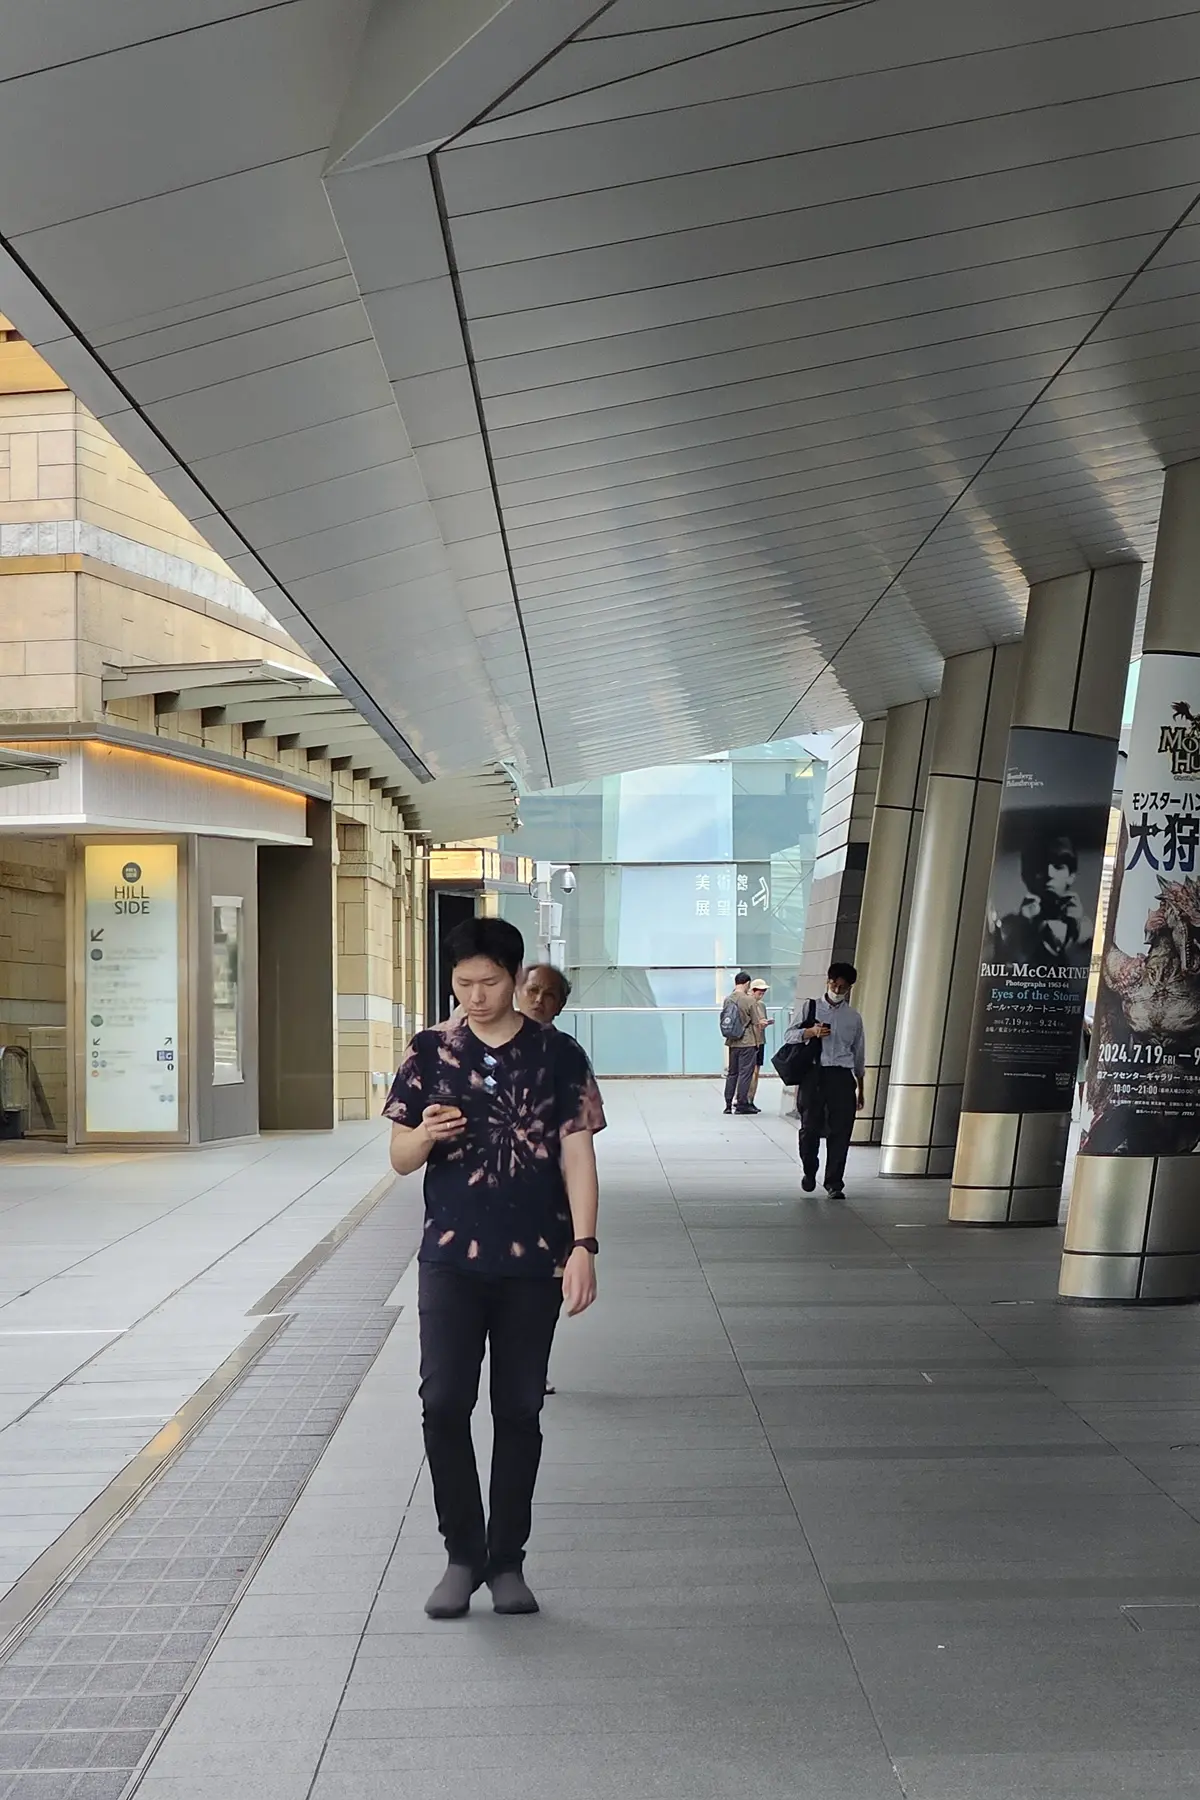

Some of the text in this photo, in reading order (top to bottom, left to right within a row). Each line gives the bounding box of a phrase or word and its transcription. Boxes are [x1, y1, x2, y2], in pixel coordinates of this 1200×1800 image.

[114, 886, 150, 899] HILL
[114, 901, 150, 914] SIDE
[980, 963, 1089, 979] PAUL McCARTNE
[1005, 980, 1046, 989] Photographs
[991, 988, 1080, 1001] Eyes of the Storm
